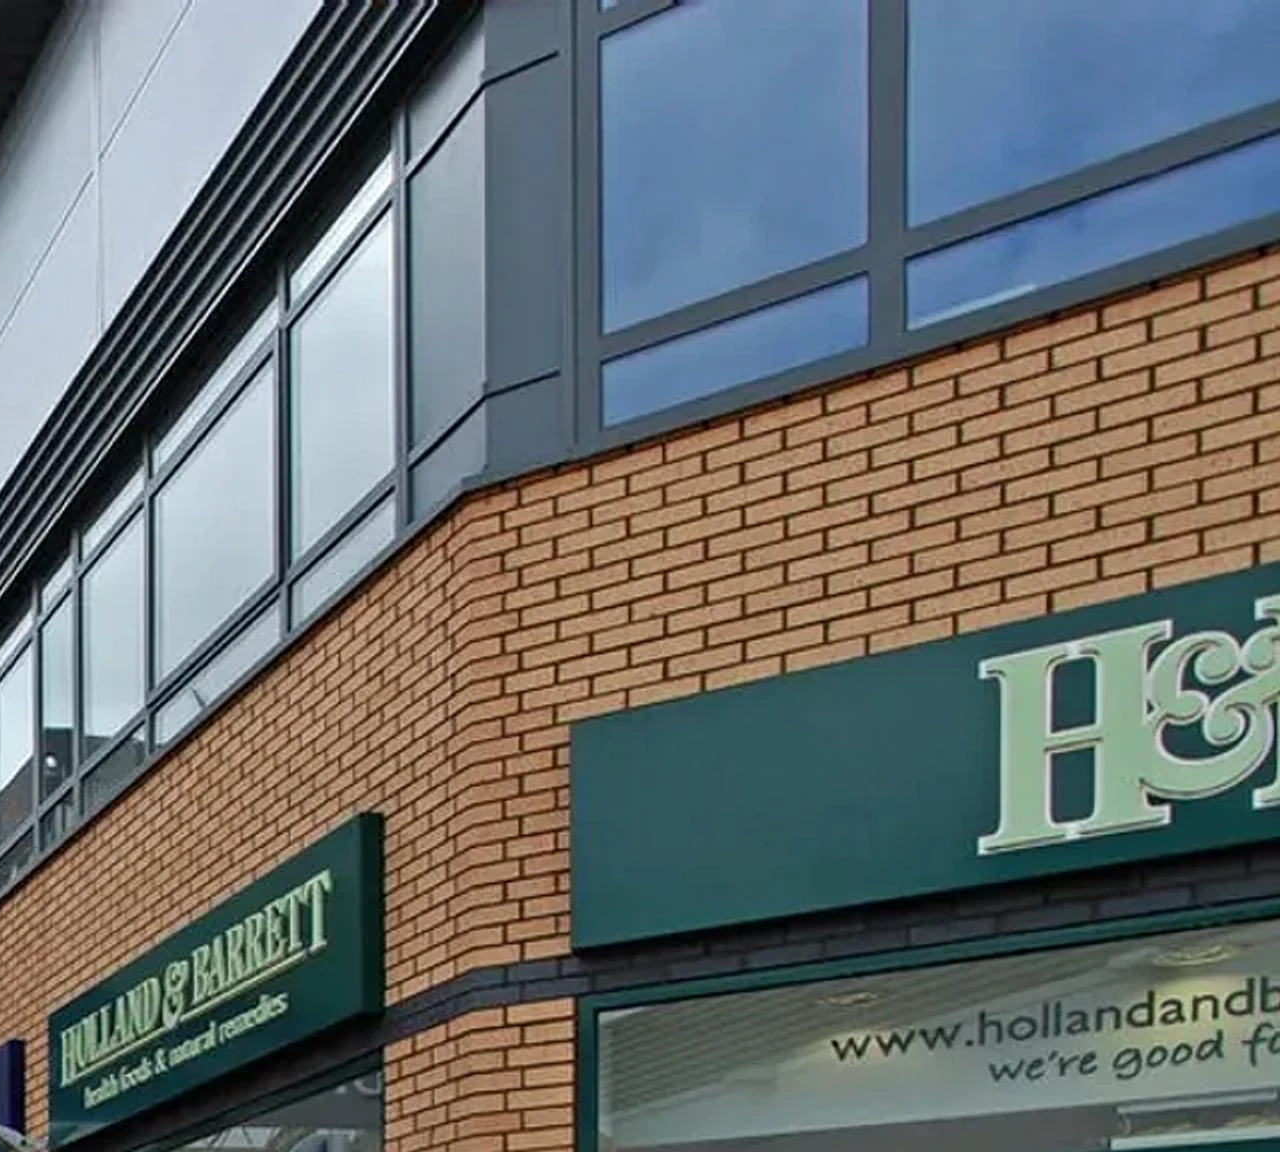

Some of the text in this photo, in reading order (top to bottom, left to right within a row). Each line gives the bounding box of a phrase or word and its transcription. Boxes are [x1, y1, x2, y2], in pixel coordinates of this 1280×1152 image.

[977, 594, 1280, 856] H&
[60, 869, 333, 1088] HOLLAND & BARRETT
[154, 1047, 168, 1075] &
[168, 1020, 217, 1068] natural
[218, 991, 290, 1044] remedies
[988, 1050, 1098, 1083] we're
[1112, 1030, 1225, 1080] good
